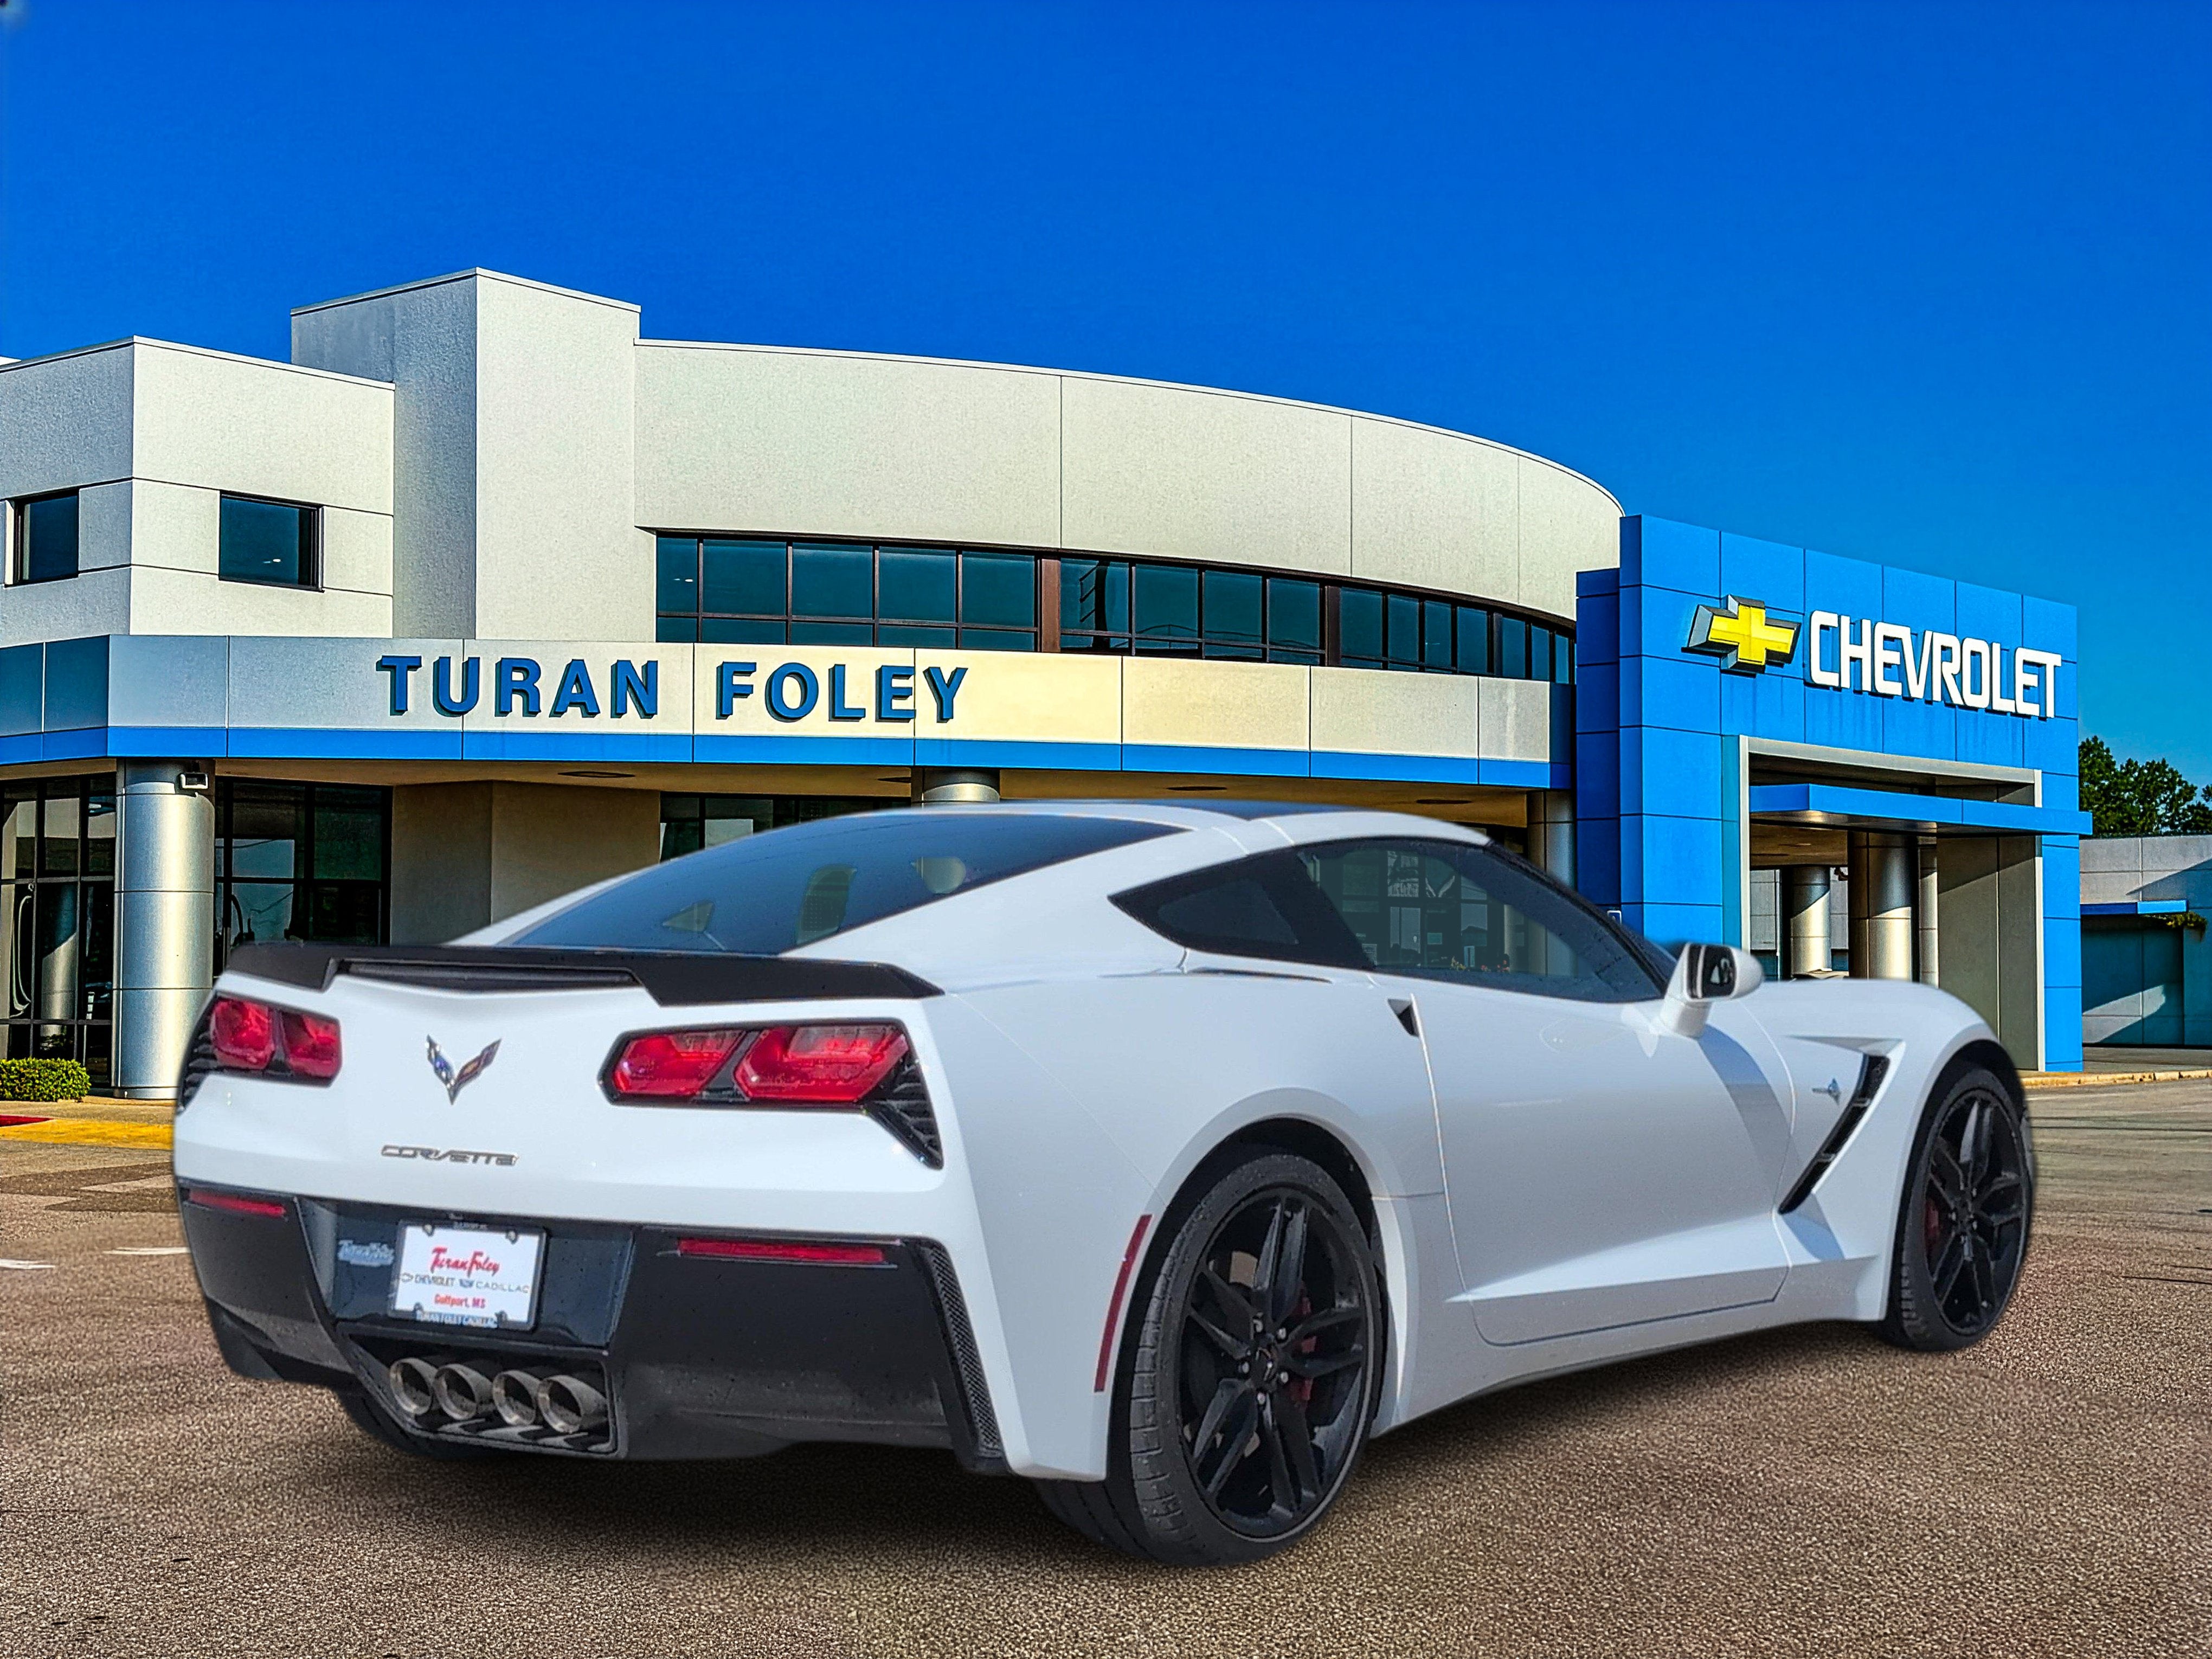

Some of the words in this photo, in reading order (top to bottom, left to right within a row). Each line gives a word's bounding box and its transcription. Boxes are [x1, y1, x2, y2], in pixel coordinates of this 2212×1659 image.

[1809, 609, 2062, 719] CHEVROLET
[376, 655, 659, 719] TURAN
[716, 660, 968, 723] FOLEY
[381, 1144, 517, 1166] CORVETTE
[475, 1281, 530, 1294] CADILLAC
